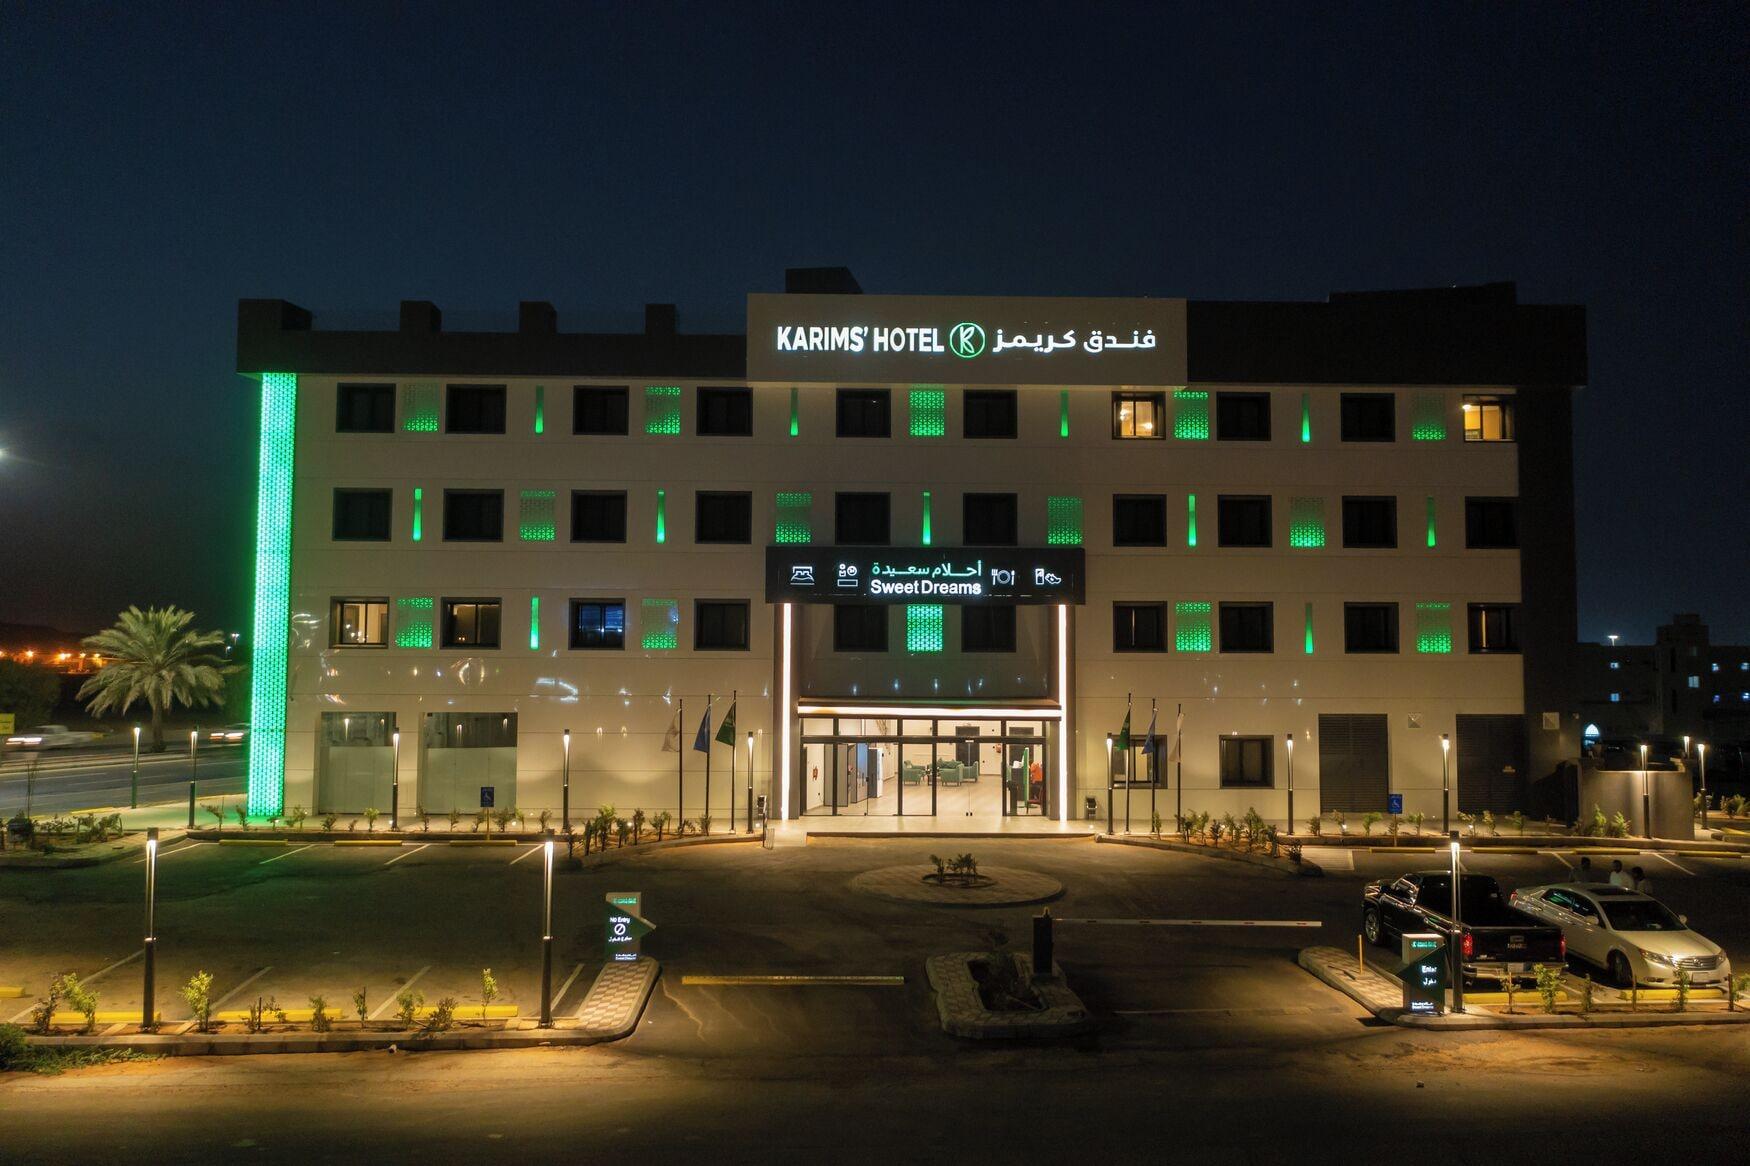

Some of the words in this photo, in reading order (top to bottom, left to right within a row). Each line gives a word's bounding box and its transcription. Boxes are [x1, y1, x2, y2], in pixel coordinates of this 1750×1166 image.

[777, 326, 868, 352] KARIMS'
[873, 327, 944, 352] HOTEL
[992, 329, 1077, 353] كريمز
[1083, 329, 1156, 353] فندق
[872, 562, 930, 577] سعيدة
[932, 559, 982, 578] أحلام
[870, 579, 920, 594] Sweet
[921, 579, 982, 595] Dreams
